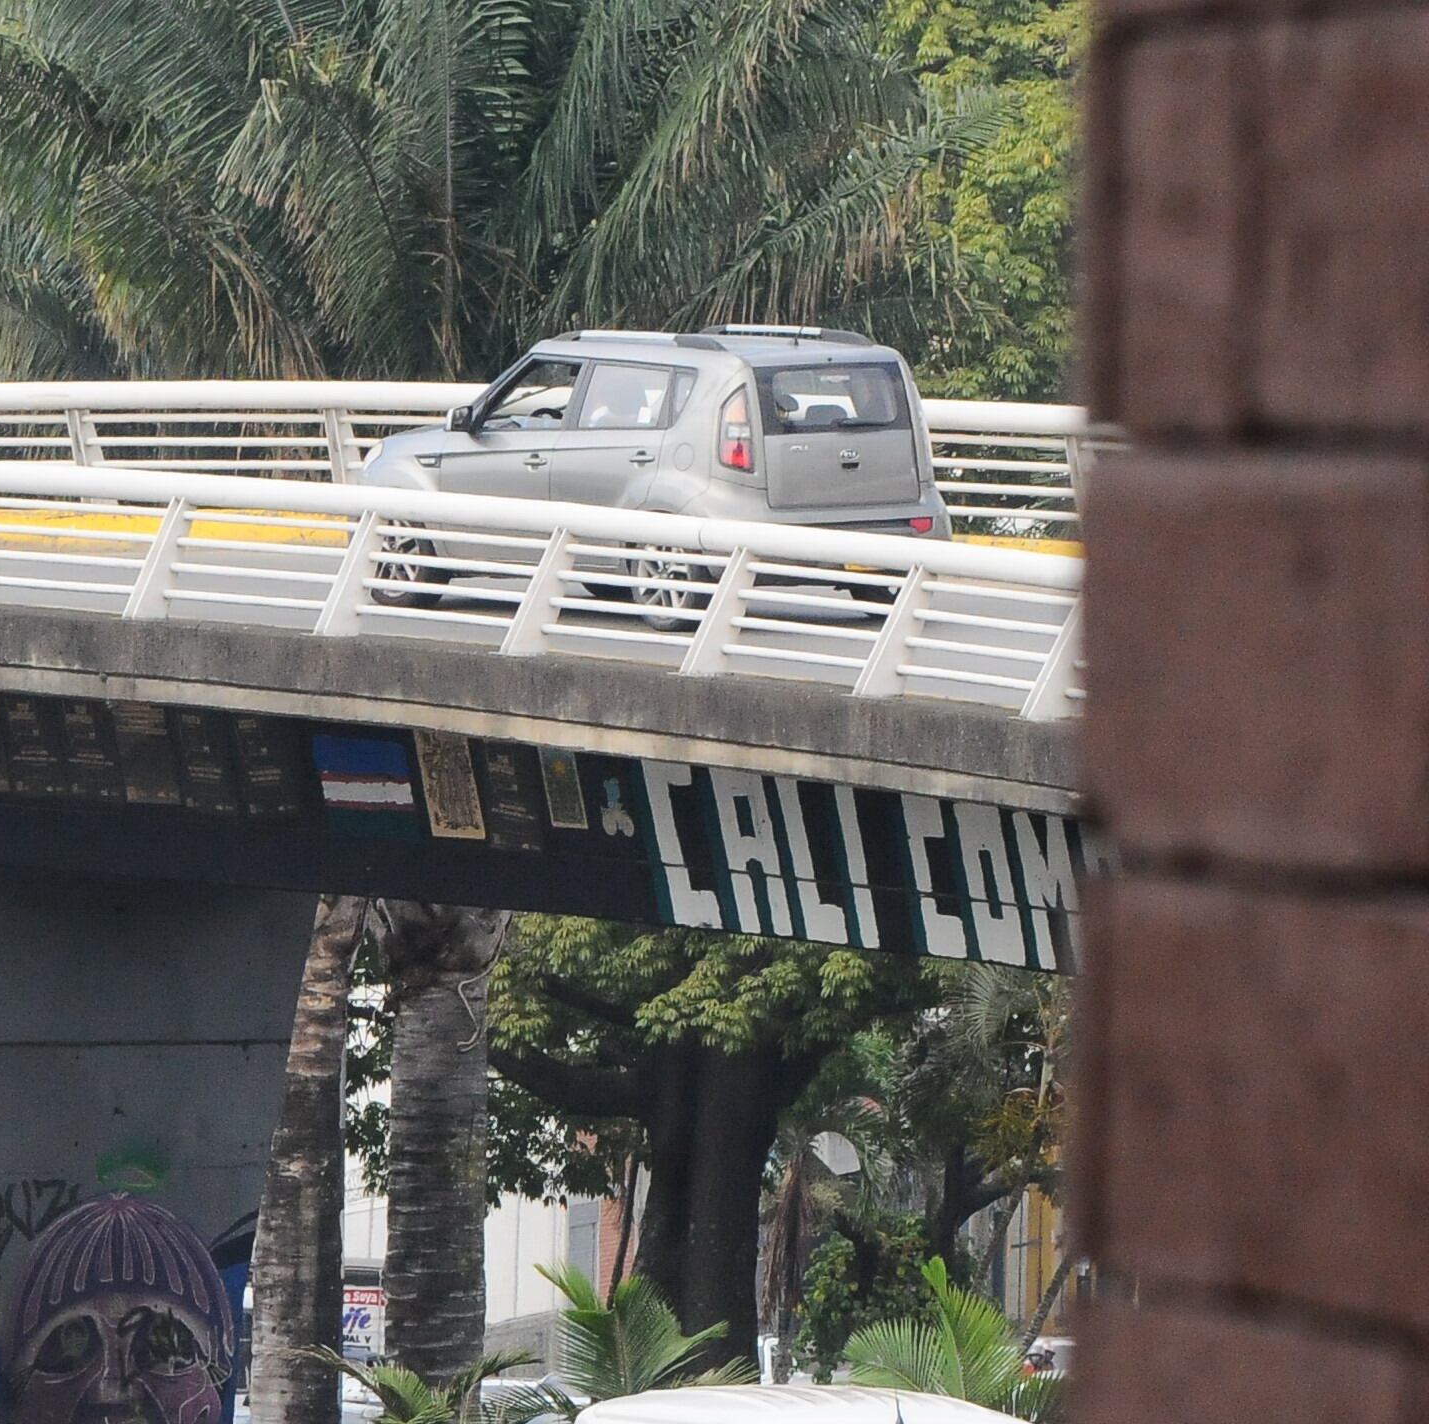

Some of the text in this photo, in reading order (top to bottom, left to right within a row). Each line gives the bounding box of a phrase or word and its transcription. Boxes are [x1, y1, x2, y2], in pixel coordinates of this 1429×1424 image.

[642, 759, 1084, 975] CALI COM
[342, 1307, 372, 1334] ife
